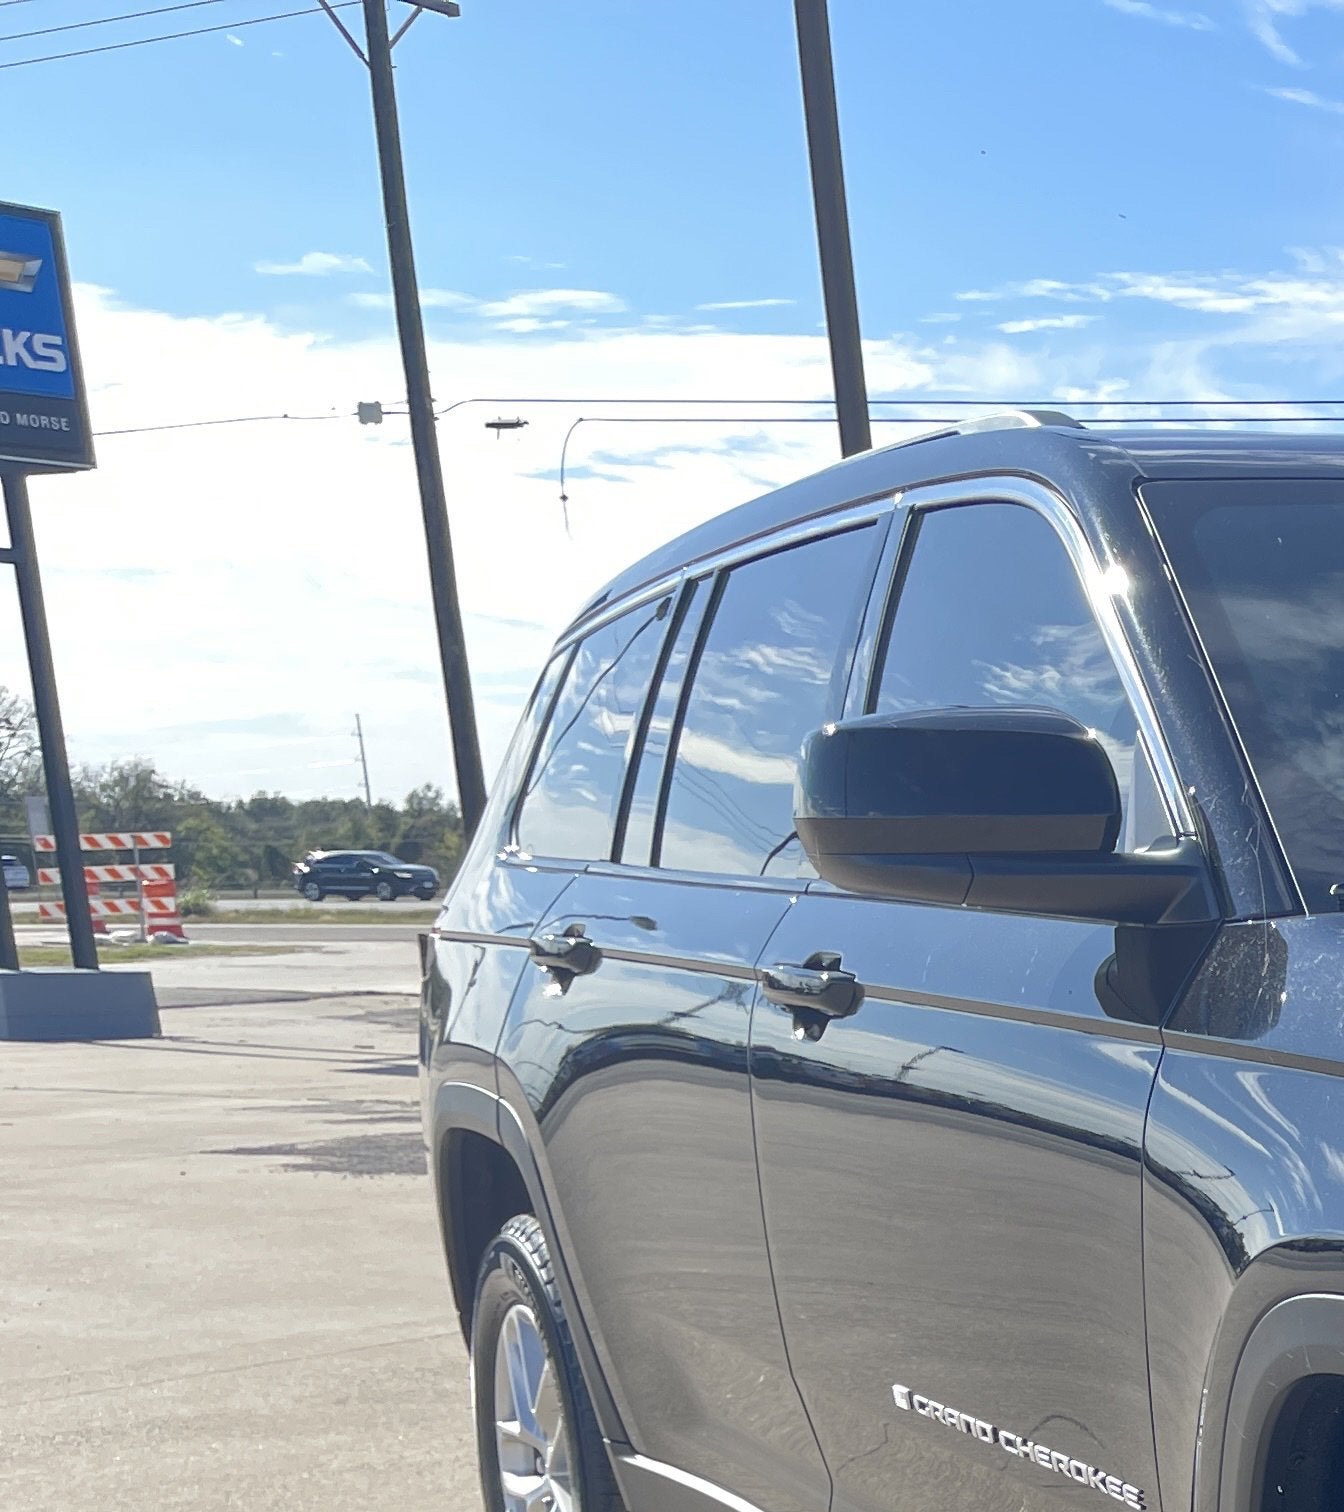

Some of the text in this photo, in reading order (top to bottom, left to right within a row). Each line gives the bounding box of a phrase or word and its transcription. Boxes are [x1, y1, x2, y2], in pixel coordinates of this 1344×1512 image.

[0, 328, 67, 372] KS
[16, 413, 70, 431] MORSE
[913, 1394, 1146, 1511] GRAND CHEROKEE
